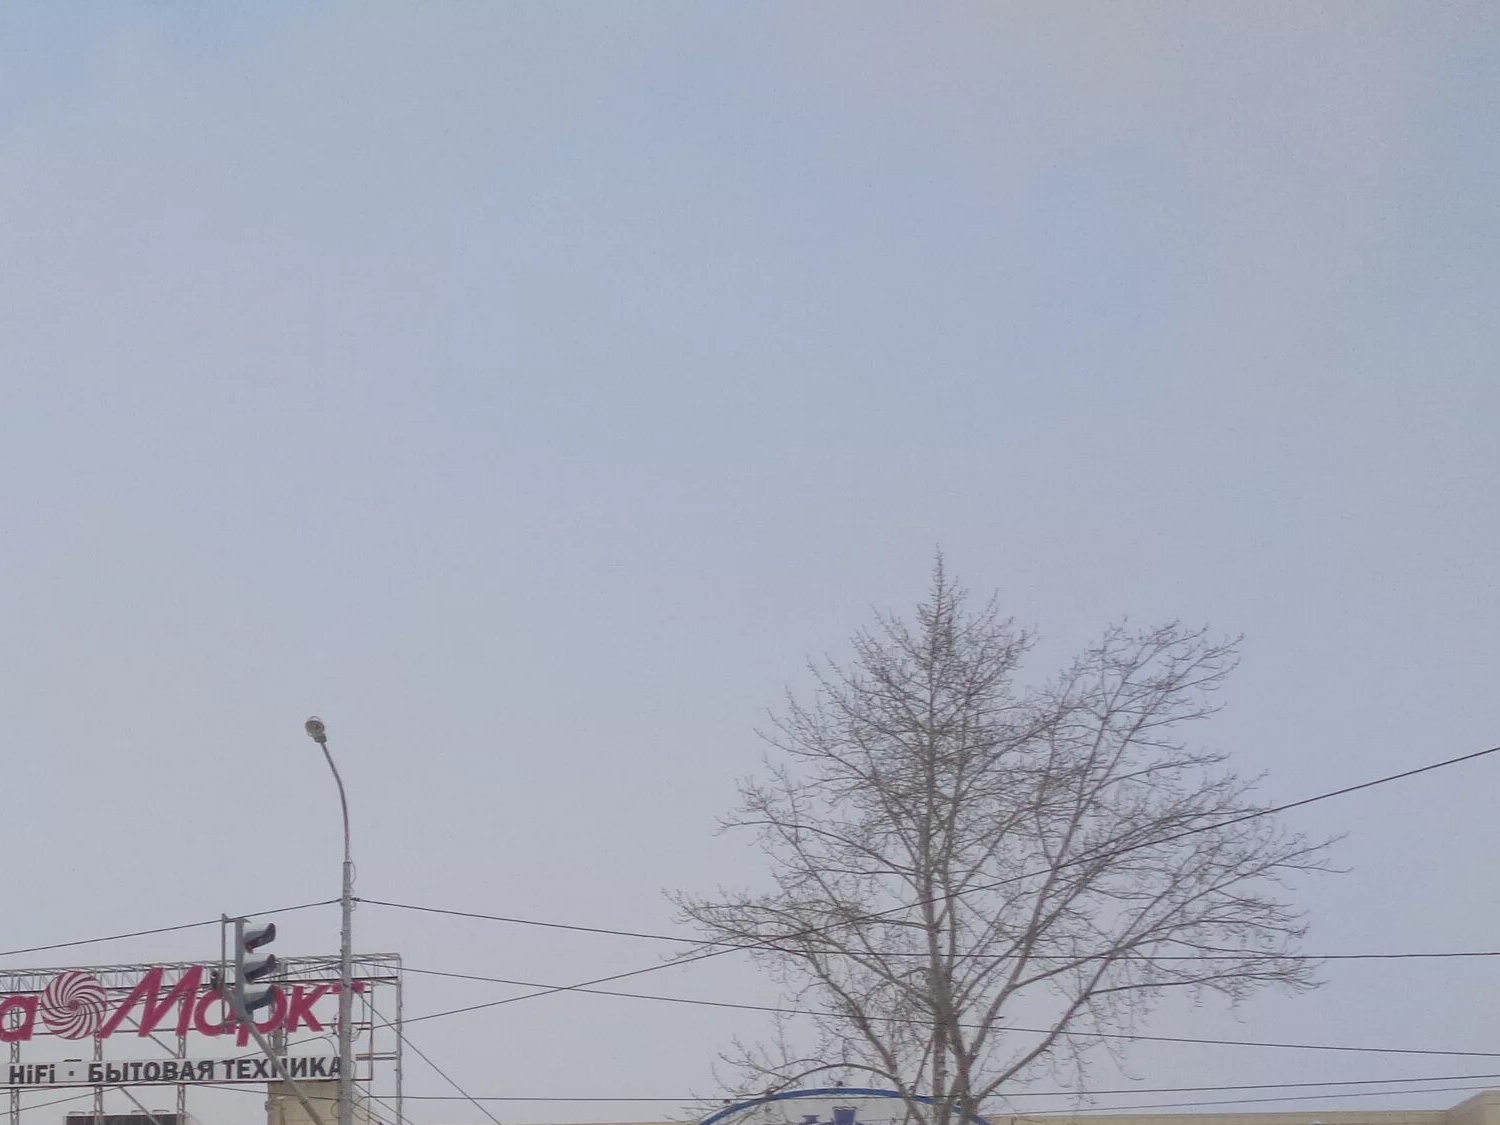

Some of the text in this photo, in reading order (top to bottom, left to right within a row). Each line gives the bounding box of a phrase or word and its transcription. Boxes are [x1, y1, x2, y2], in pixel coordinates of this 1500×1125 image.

[8, 1064, 55, 1085] HiFi
[87, 1060, 214, 1082] БЫТОВАЯ
[222, 1056, 343, 1080] ТЕХНИКА
